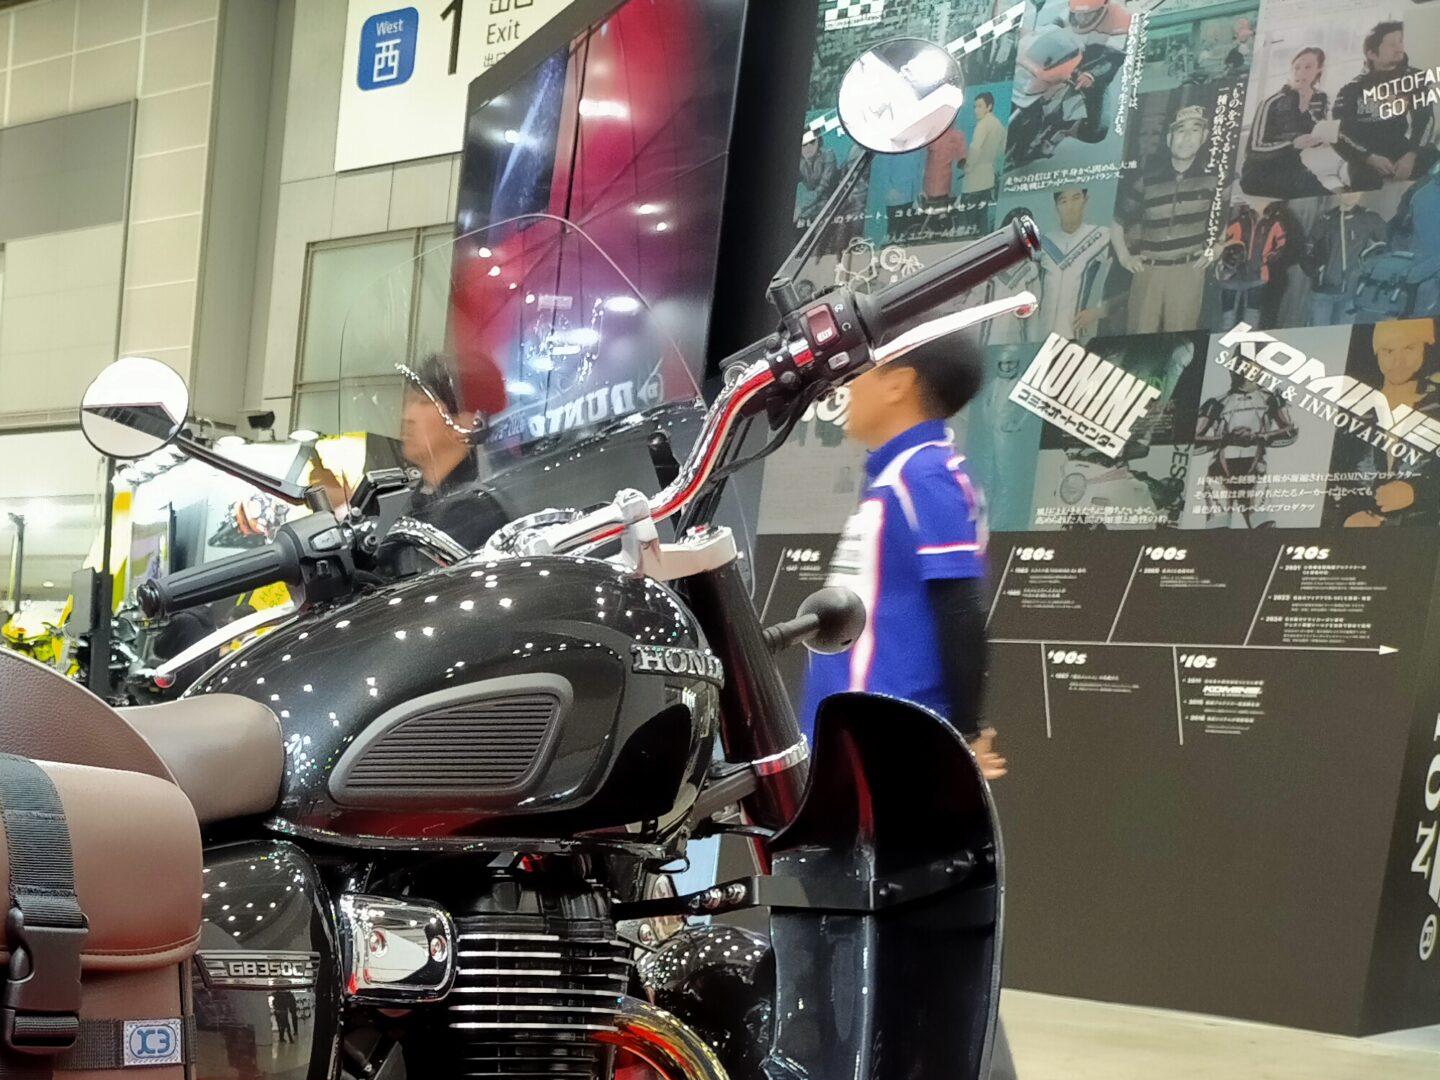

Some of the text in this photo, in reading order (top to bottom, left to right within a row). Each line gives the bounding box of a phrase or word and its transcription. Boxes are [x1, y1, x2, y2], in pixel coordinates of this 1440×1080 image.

[376, 18, 404, 36] West
[440, 0, 462, 75] 1
[487, 19, 520, 45] Exit
[373, 39, 401, 82] 西
[1379, 98, 1405, 120] GO
[1022, 332, 1162, 441] KOMINE
[1215, 350, 1424, 466] SAFETY & INNOVATION
[1218, 321, 1440, 453] KOMINE
[1018, 388, 1116, 449] コミネオートセンター
[638, 647, 724, 680] HOND
[229, 962, 304, 976] GB350C
